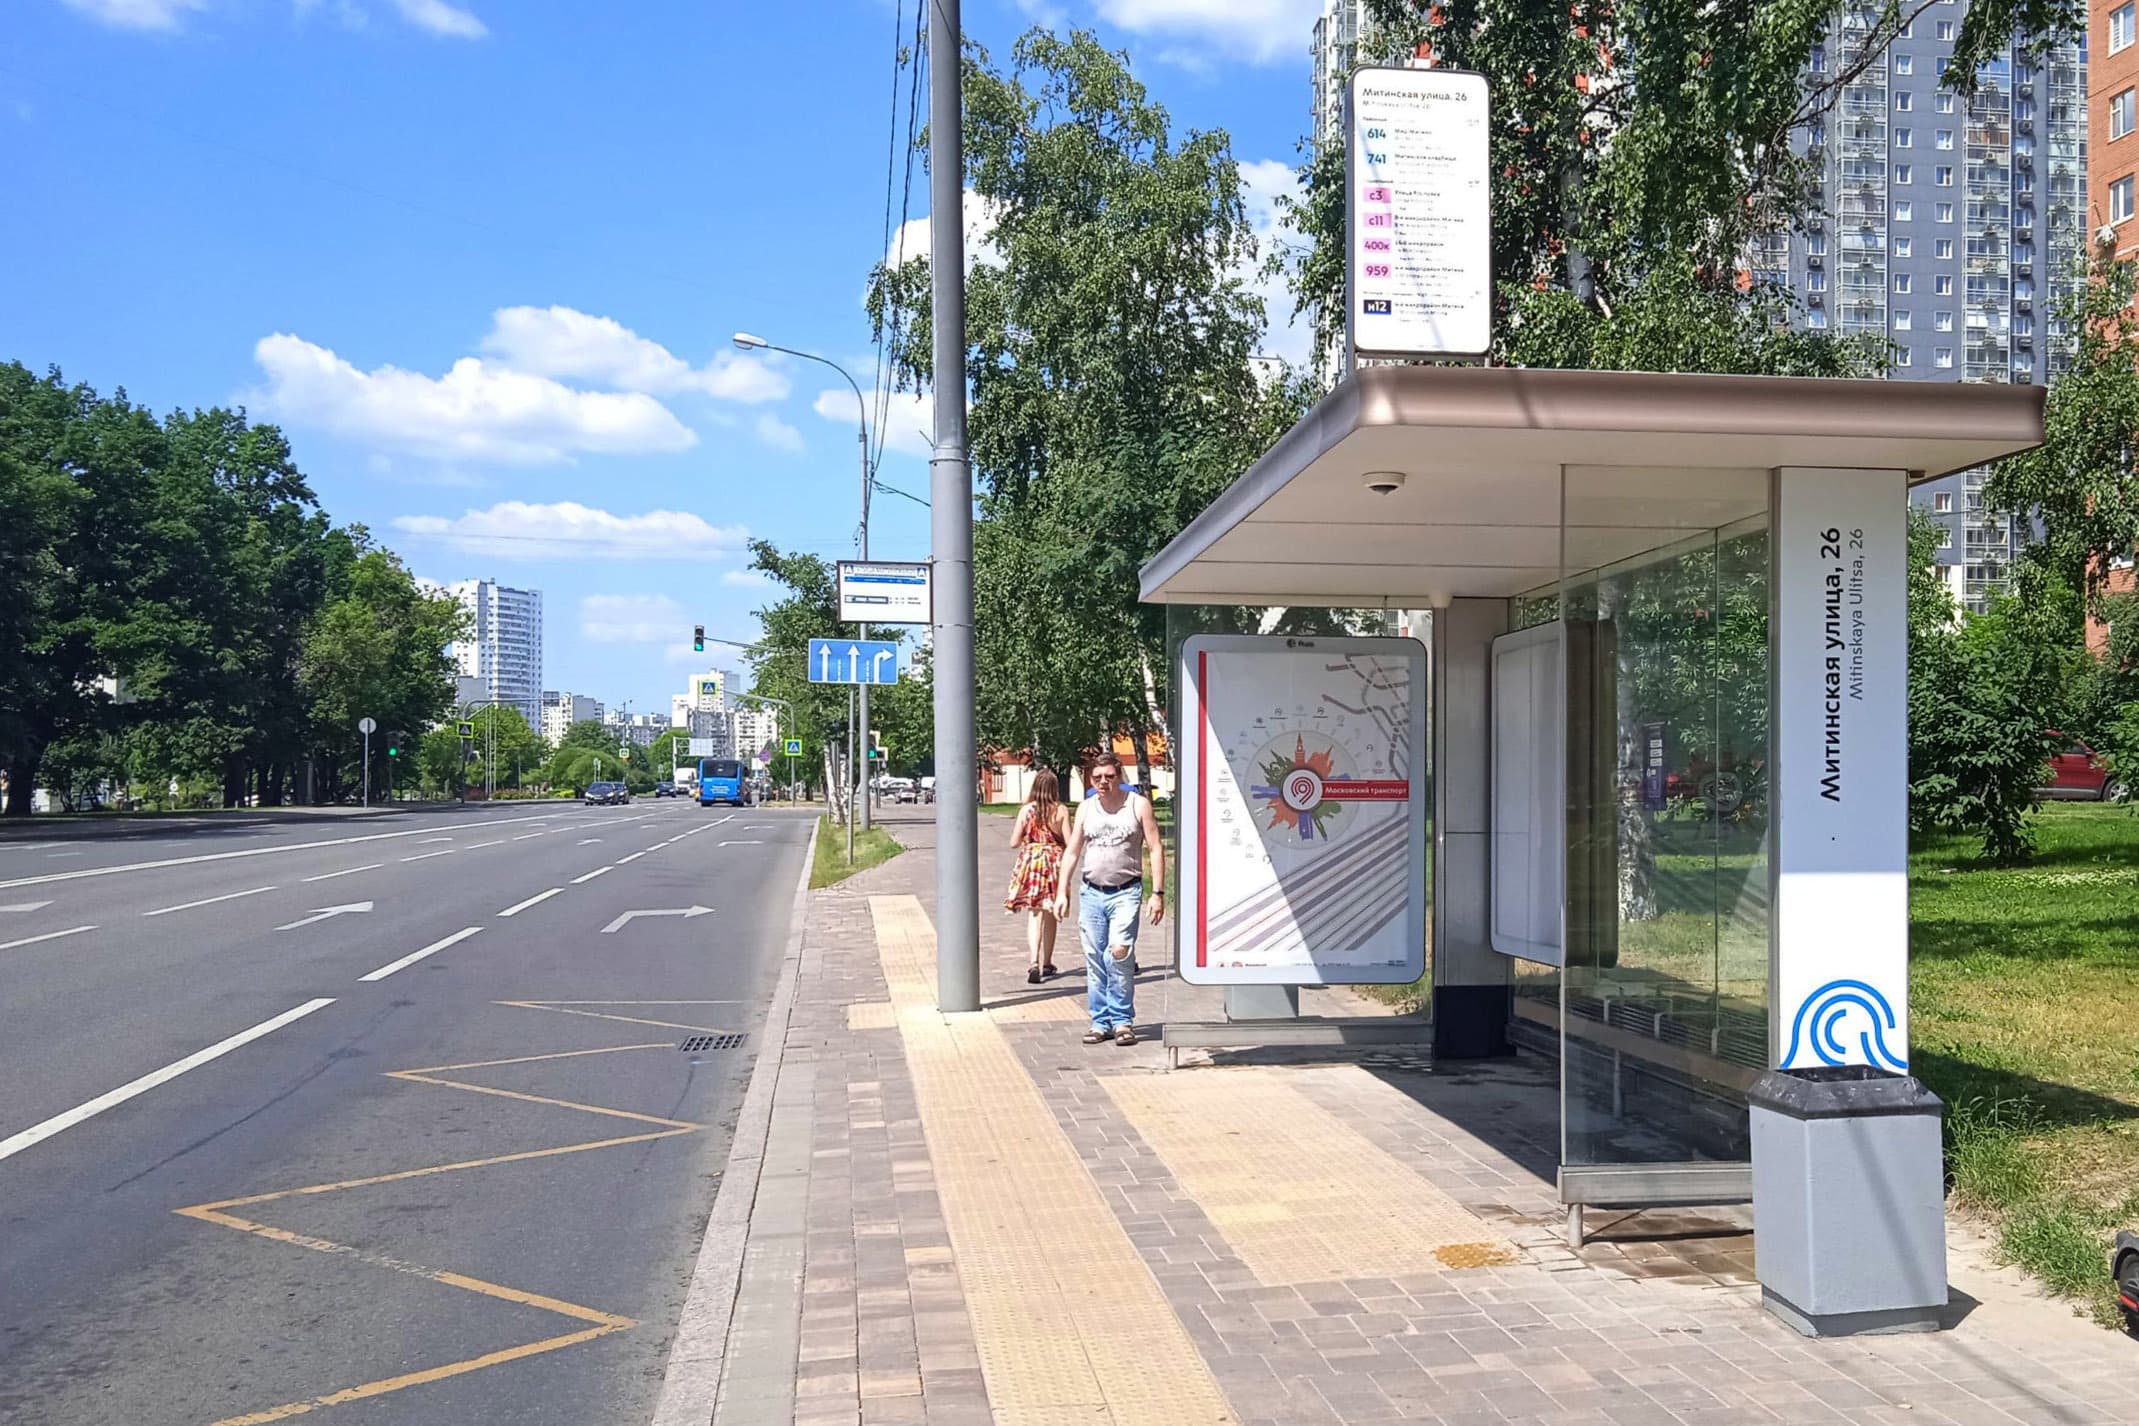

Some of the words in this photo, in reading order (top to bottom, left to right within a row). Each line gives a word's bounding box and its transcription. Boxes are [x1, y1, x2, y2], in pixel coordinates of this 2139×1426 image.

[1362, 88, 1419, 98] Митинская
[1455, 92, 1468, 101] 26
[1367, 128, 1387, 139] 614
[1367, 153, 1387, 164] 741
[1366, 265, 1389, 277] 959
[1820, 527, 1841, 559] 26
[1848, 528, 1864, 549] 26
[1848, 555, 1865, 605] Ulitsa,
[1825, 566, 1845, 650] улица,
[1848, 610, 1865, 701] Mitinskaya
[1820, 656, 1841, 802] Митинская
[1324, 786, 1370, 794] Московский
[1371, 787, 1407, 795] транспорт
